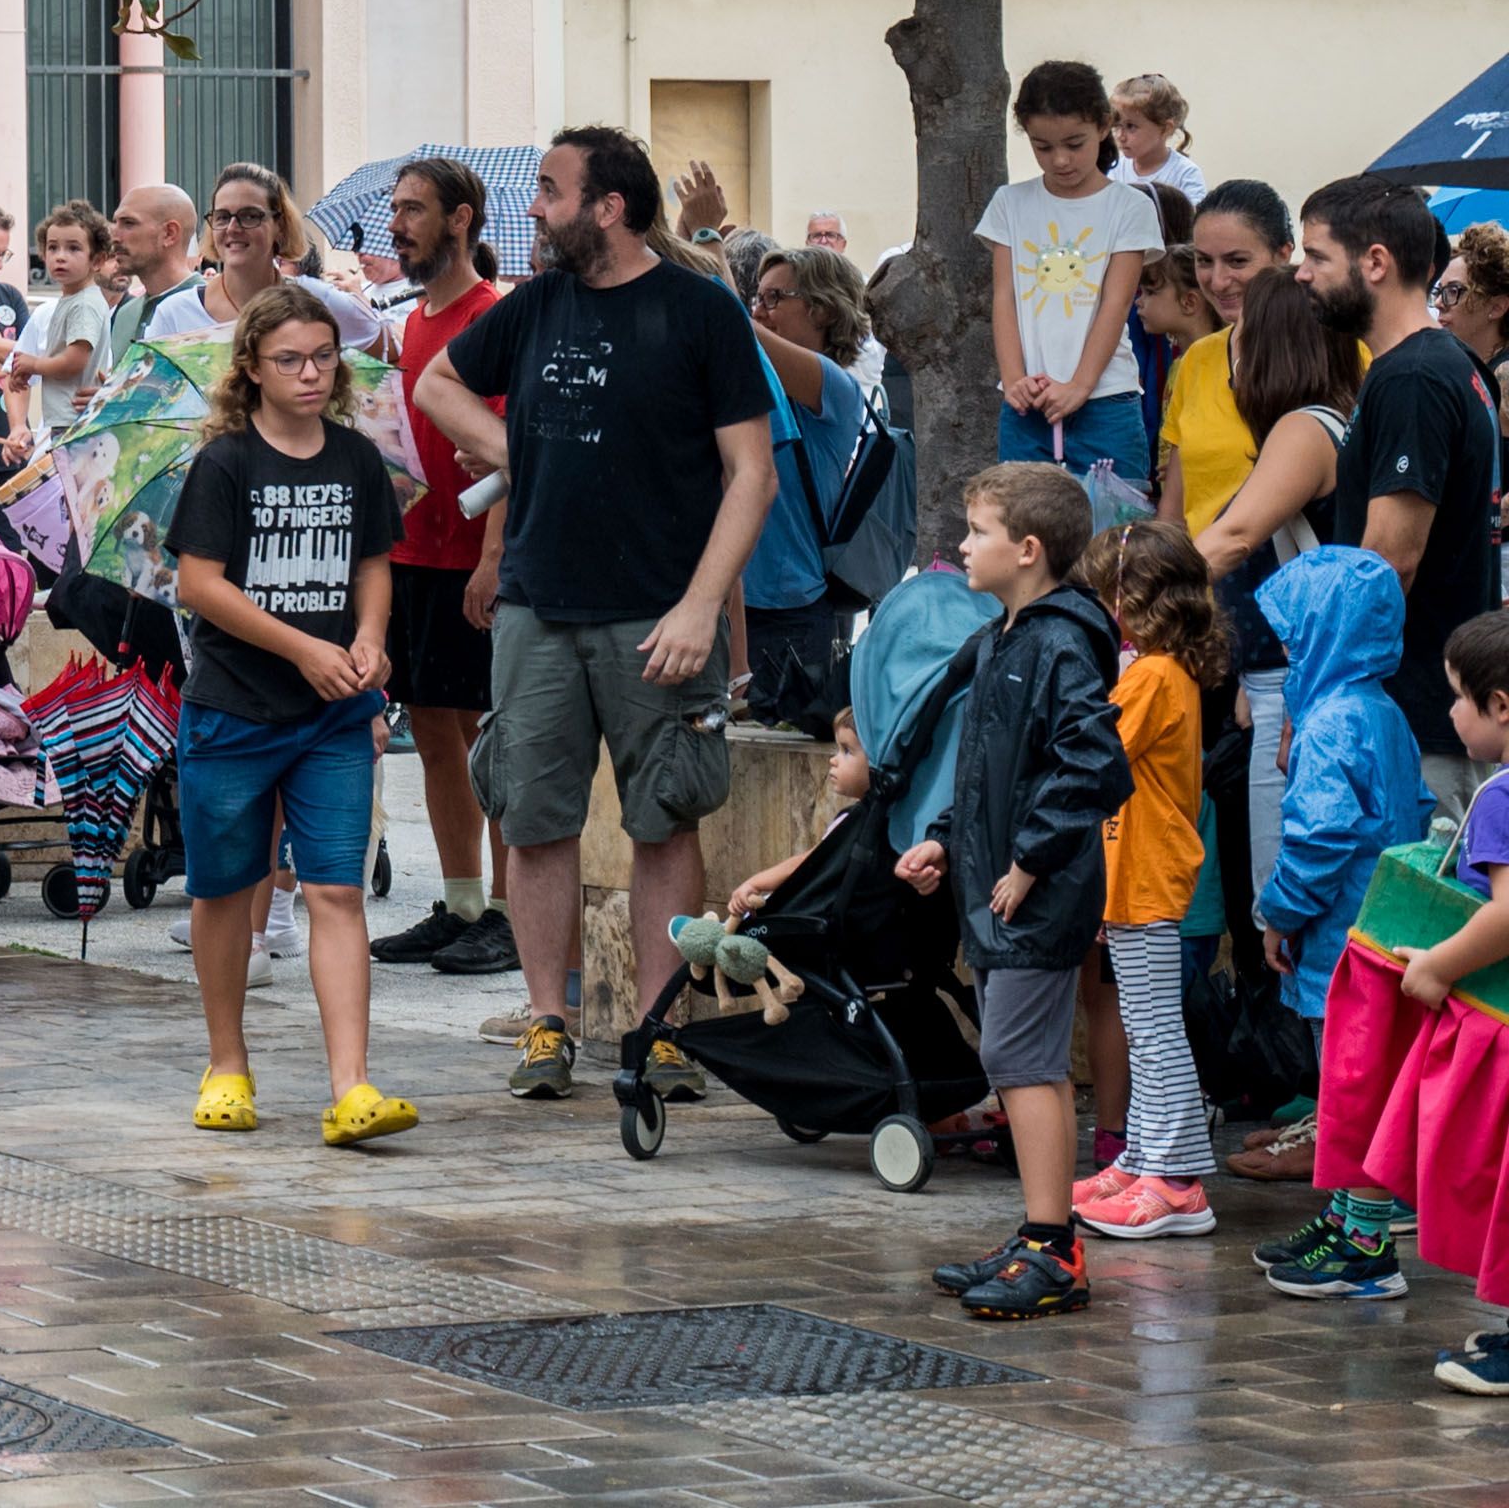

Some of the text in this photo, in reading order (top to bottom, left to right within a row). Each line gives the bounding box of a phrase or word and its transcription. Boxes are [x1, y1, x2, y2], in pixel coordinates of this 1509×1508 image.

[262, 483, 344, 507] 88 KEYS
[251, 504, 353, 528] 10 FINGERS
